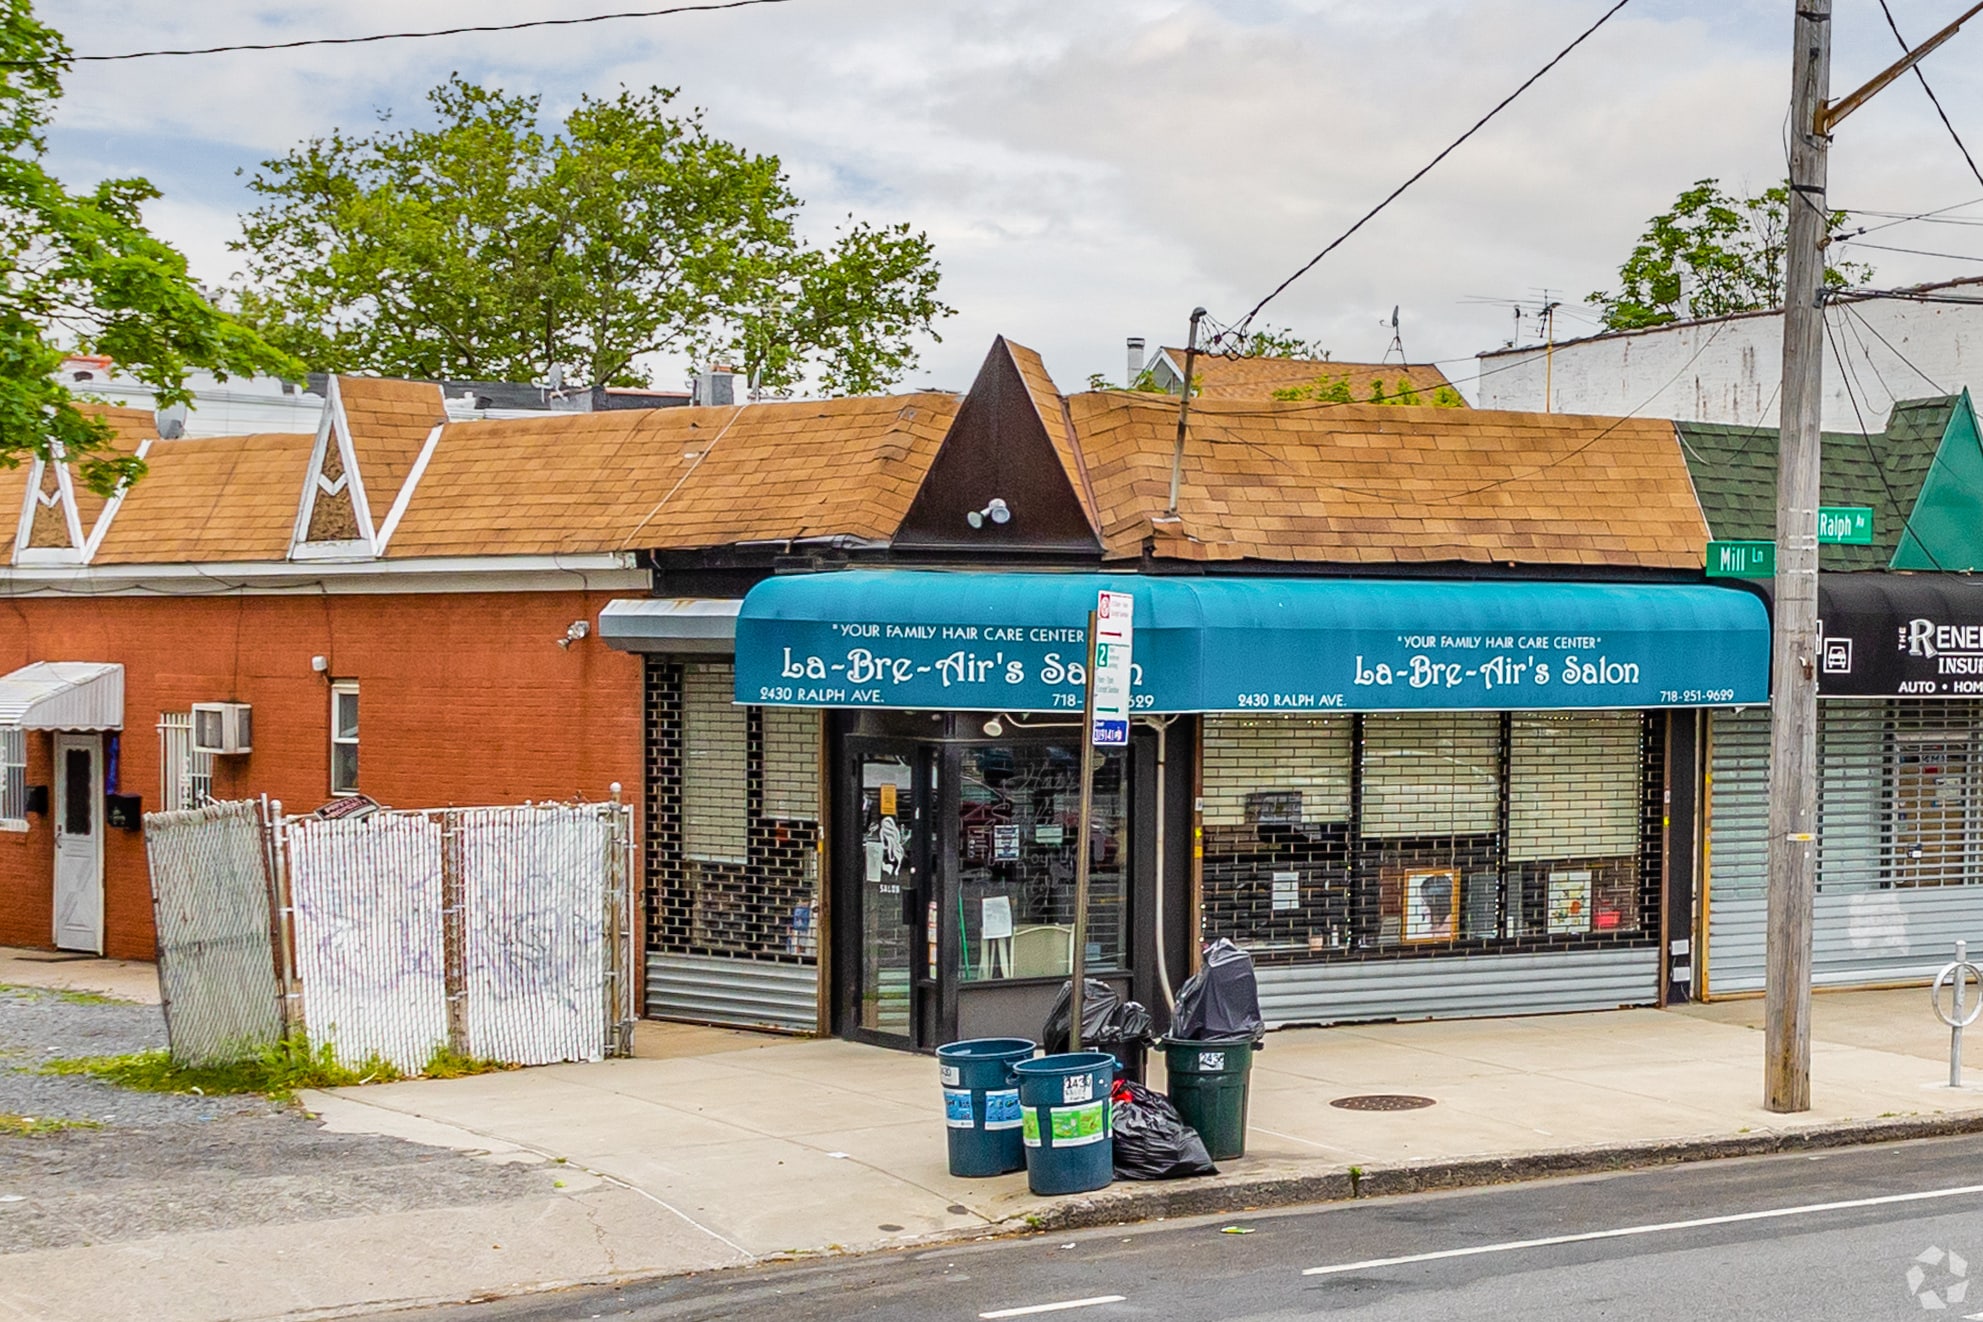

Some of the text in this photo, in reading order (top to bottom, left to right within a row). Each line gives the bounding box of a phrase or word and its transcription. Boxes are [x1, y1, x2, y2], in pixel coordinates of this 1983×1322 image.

[1820, 513, 1865, 542] Ralph Av
[1720, 547, 1763, 571] Mill Ln
[886, 625, 937, 640] FAMILY
[942, 626, 978, 640] HAIR
[983, 627, 1024, 642] CARE
[1029, 628, 1085, 643] CENTER
[1440, 636, 1481, 649] FAMILY
[1485, 636, 1514, 649] HAIR
[1518, 636, 1549, 649] CARE
[1553, 636, 1601, 649] CENTER"
[1908, 618, 1983, 659] RENE
[781, 647, 1025, 687] La-Bre-Air's
[1040, 652, 1144, 686] San
[1354, 654, 1640, 690] La-Bre-Air's Salon
[760, 686, 885, 703] 2430 RALPH AVE.
[1660, 689, 1734, 703] 718-251-9629
[1898, 681, 1936, 693] AUTO
[1238, 693, 1347, 707] 2430 RALPH AVE.
